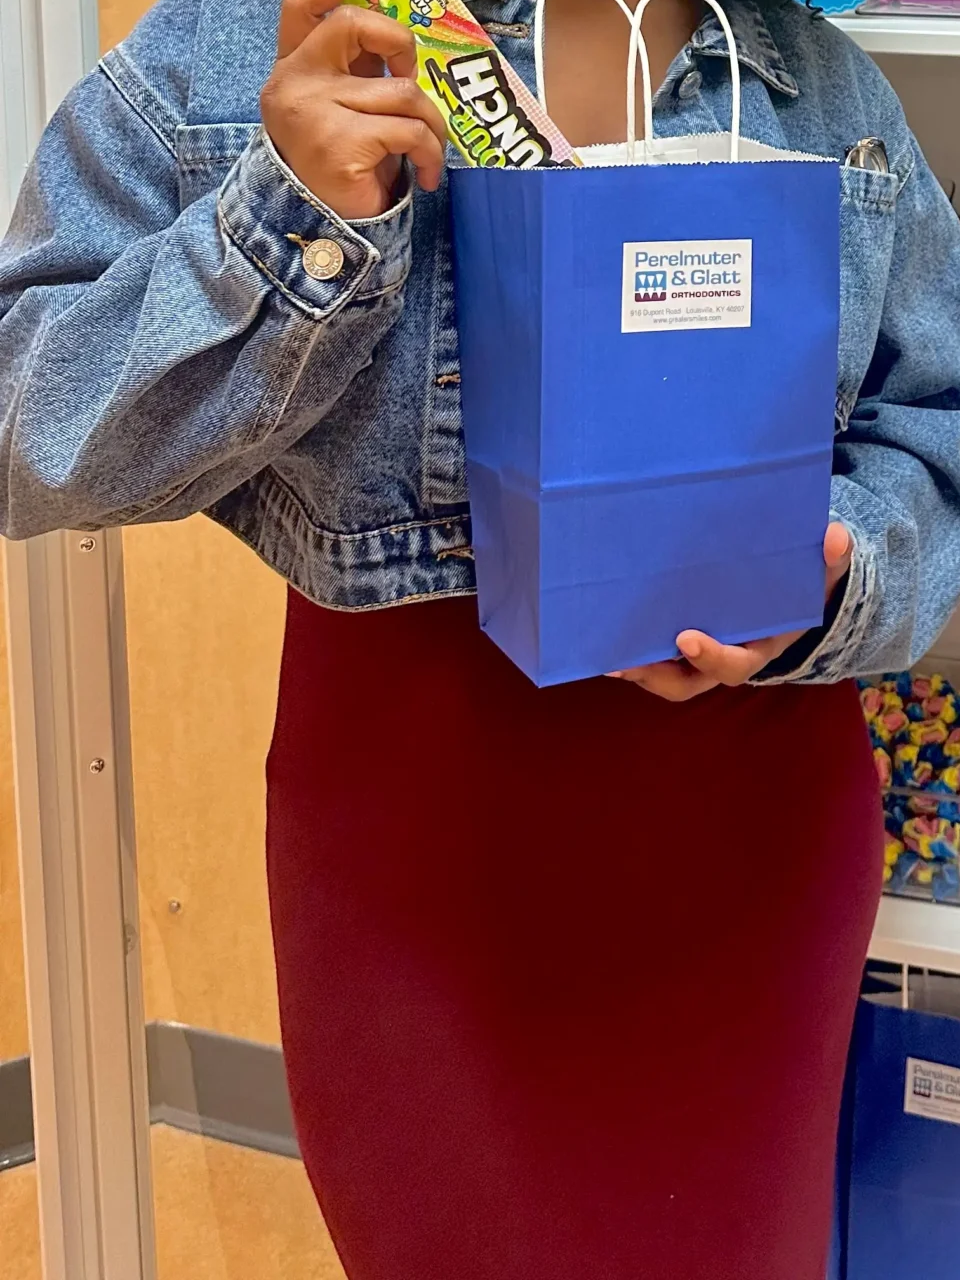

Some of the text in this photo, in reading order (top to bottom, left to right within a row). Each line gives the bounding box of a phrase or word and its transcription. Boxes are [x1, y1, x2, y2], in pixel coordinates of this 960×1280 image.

[451, 56, 544, 168] UNCH
[450, 104, 507, 168] OUR
[635, 250, 741, 267] Perelmuter
[671, 269, 741, 286] & Glatt
[671, 290, 741, 299] ORTHODONTICS
[643, 308, 664, 318] Dupont
